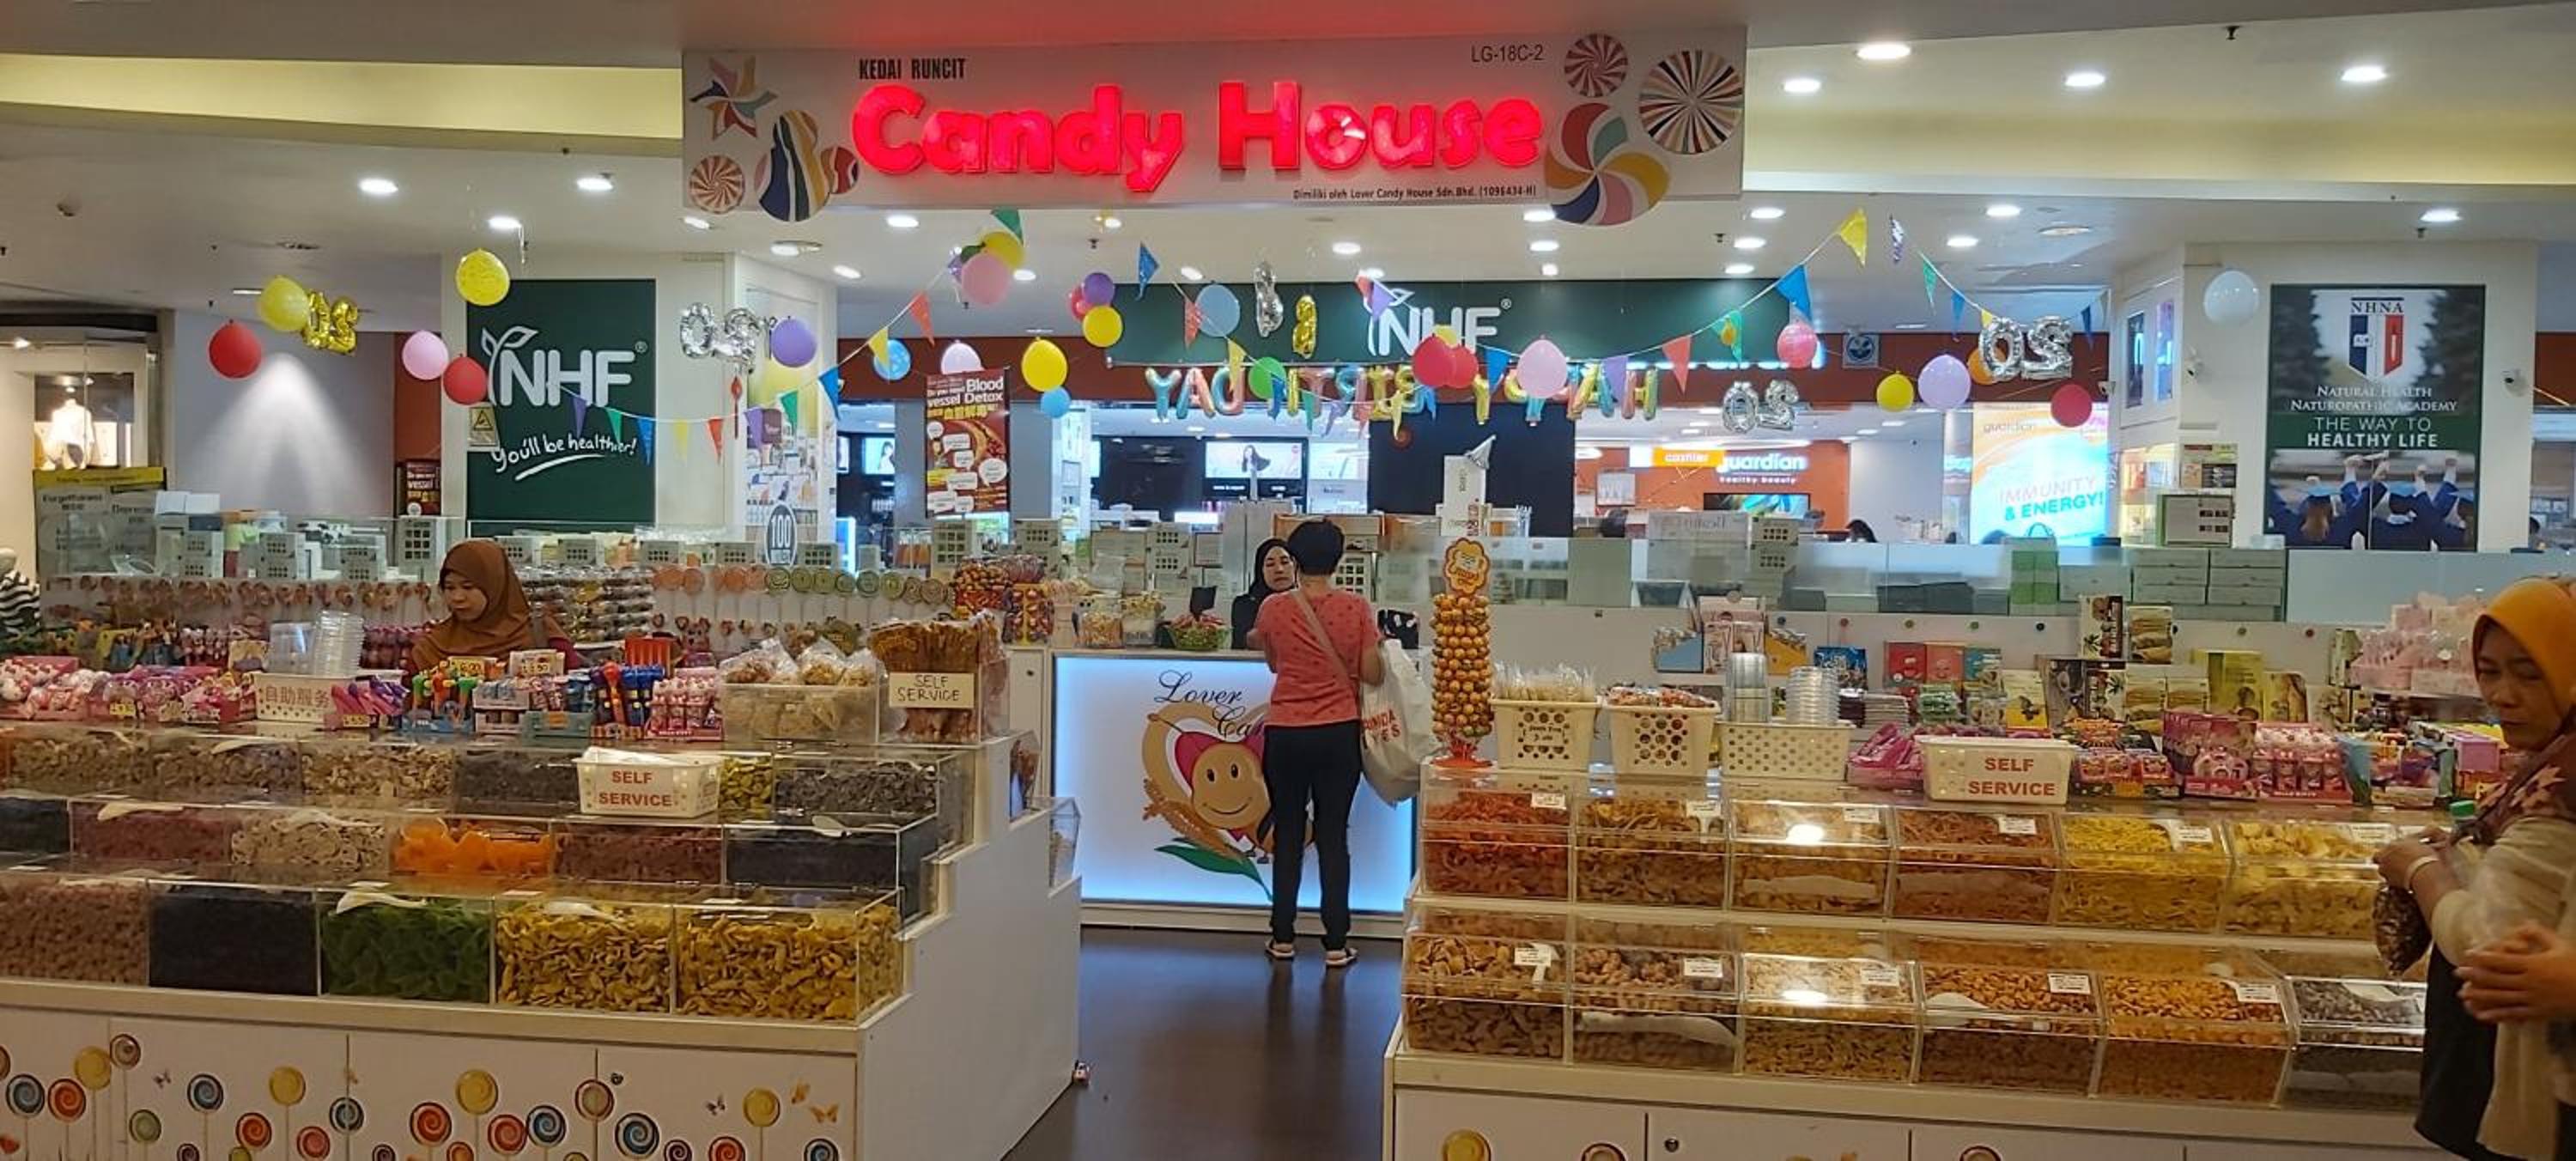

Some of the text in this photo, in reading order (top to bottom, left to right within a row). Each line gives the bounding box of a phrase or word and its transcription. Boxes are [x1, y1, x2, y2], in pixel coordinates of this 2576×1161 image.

[1471, 44, 1545, 64] LG-18C-2
[859, 58, 966, 80] KEDAI RUNCIT
[853, 82, 1544, 192] Candy House
[1376, 186, 1404, 200] Candy
[1406, 186, 1433, 198] House
[2350, 301, 2404, 314] NHNA
[500, 350, 635, 407] NHF
[966, 375, 1004, 392] Blood
[927, 391, 1004, 408] vessel Detox
[2396, 400, 2458, 411] ACADEMY
[2313, 416, 2432, 432] THE WAY TO
[544, 433, 565, 453] be
[2307, 433, 2439, 447] HEALTHY LIFE
[2000, 474, 2096, 504] IMMUNITY
[2020, 491, 2105, 519] ENERGY!
[770, 514, 791, 549] 100
[913, 674, 949, 690] SELF
[1153, 670, 1242, 704] Lover
[265, 686, 329, 708] 自助服务
[897, 687, 960, 702] SERVICE
[1984, 757, 2034, 772] SELF
[612, 770, 653, 784] SELF
[1968, 781, 2056, 796] SERVICE
[599, 792, 673, 806] SERVICE
